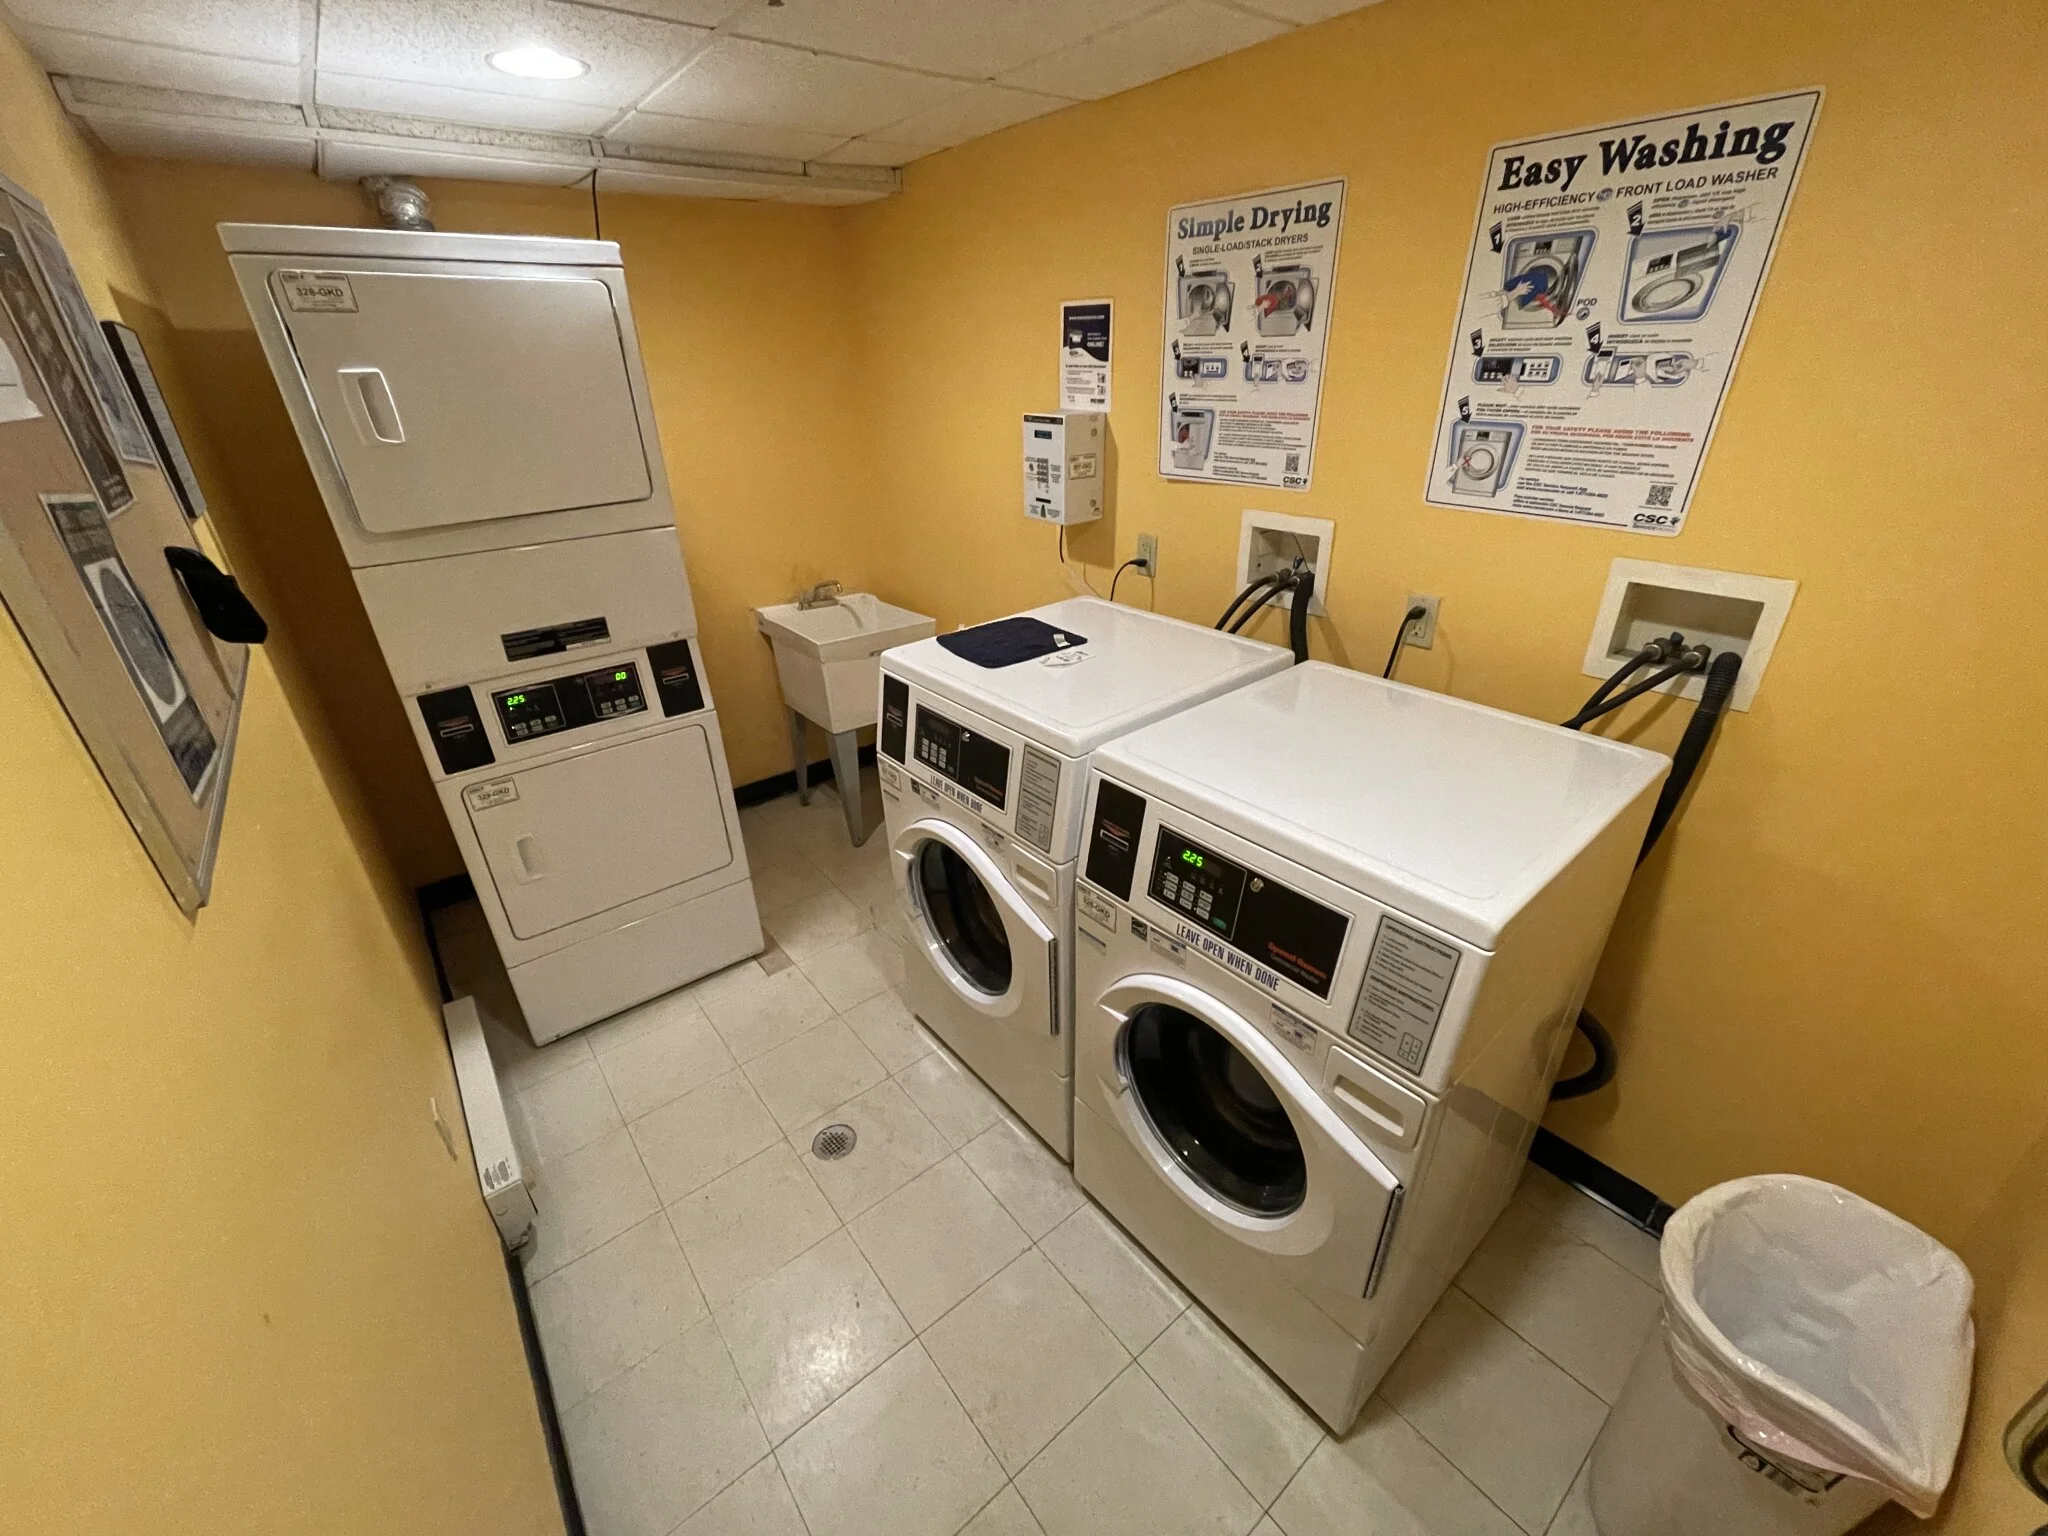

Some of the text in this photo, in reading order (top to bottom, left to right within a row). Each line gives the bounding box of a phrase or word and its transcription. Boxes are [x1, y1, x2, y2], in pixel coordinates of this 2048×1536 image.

[1497, 120, 1796, 192] Easy Washing
[1493, 191, 1596, 215] HIGH-EFFICIENCY
[1616, 182, 1663, 198] FRONT
[1666, 176, 1707, 192] LOAD
[1711, 166, 1779, 187] WASHER
[1177, 200, 1333, 241] Simple Drying
[1630, 214, 1642, 227] 2
[1192, 237, 1272, 255] SINGLE-LOAD/STACK
[1274, 233, 1309, 245] DRYERS
[1576, 297, 1598, 307] POD
[1282, 475, 1302, 485] CSC
[1632, 513, 1669, 525] CSC
[930, 774, 983, 814] LEAVE OPEN WHEN DONE
[1176, 923, 1280, 992] LEAVE OPEN WHEN DONE
[1414, 938, 1453, 960] INSTRUCTIONS
